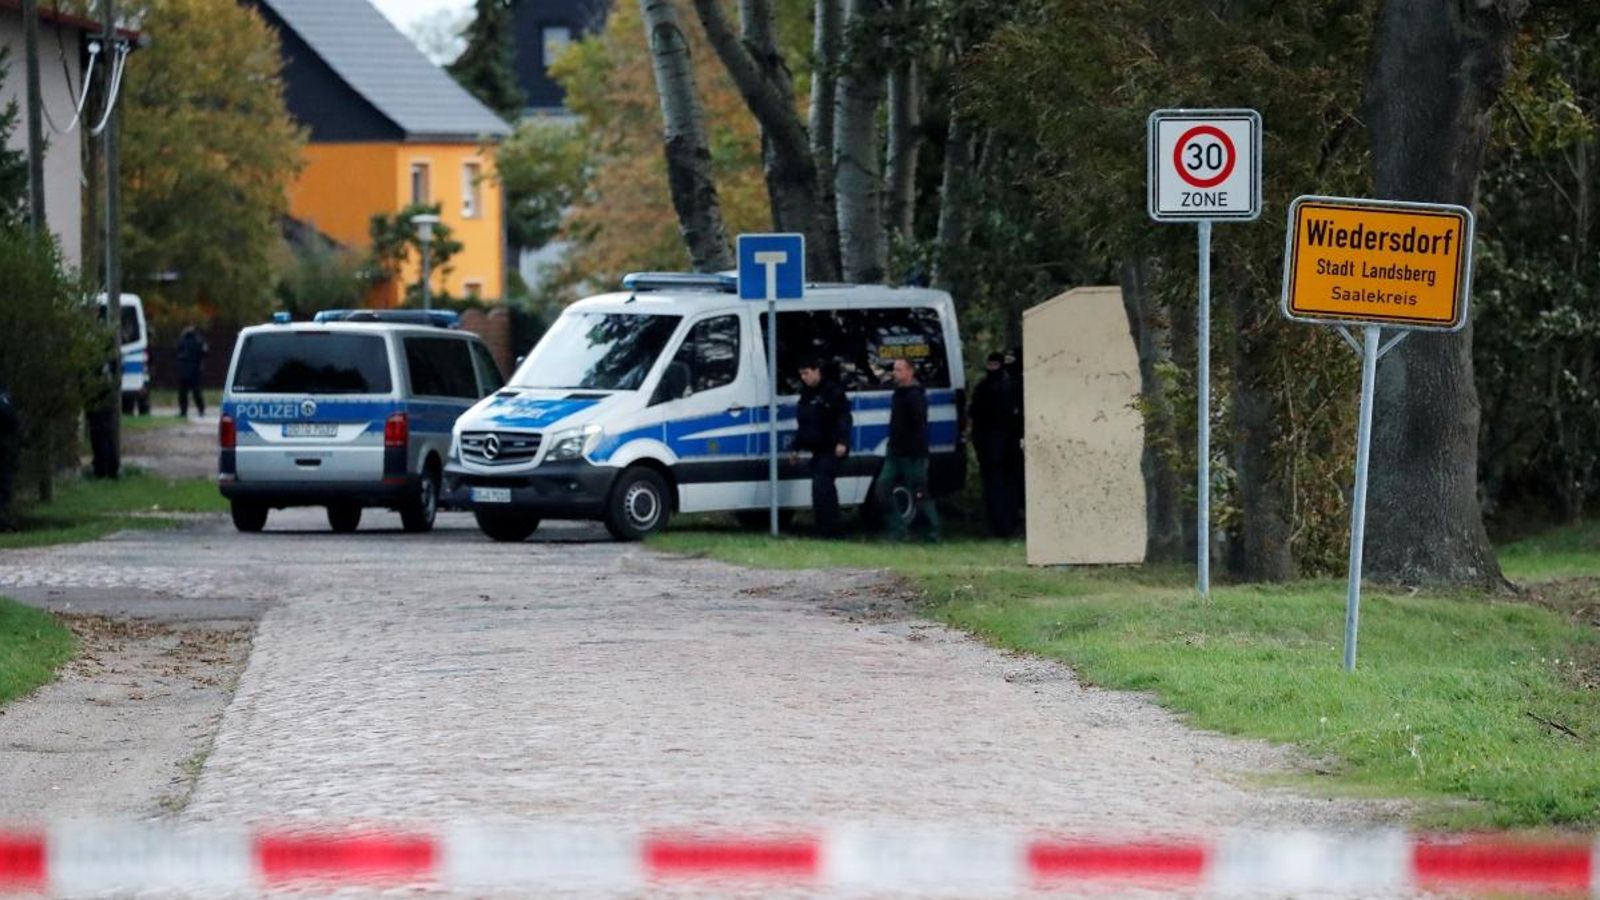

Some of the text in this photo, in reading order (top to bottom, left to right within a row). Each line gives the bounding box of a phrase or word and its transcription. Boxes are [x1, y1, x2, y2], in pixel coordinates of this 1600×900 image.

[1186, 143, 1222, 170] 30
[1181, 192, 1228, 207] ZONE
[1307, 219, 1453, 255] Wiedersdorf
[1316, 258, 1436, 286] Stadt Landsberg
[1331, 286, 1417, 305] Saalekreis
[235, 404, 298, 418] POLIZEI
